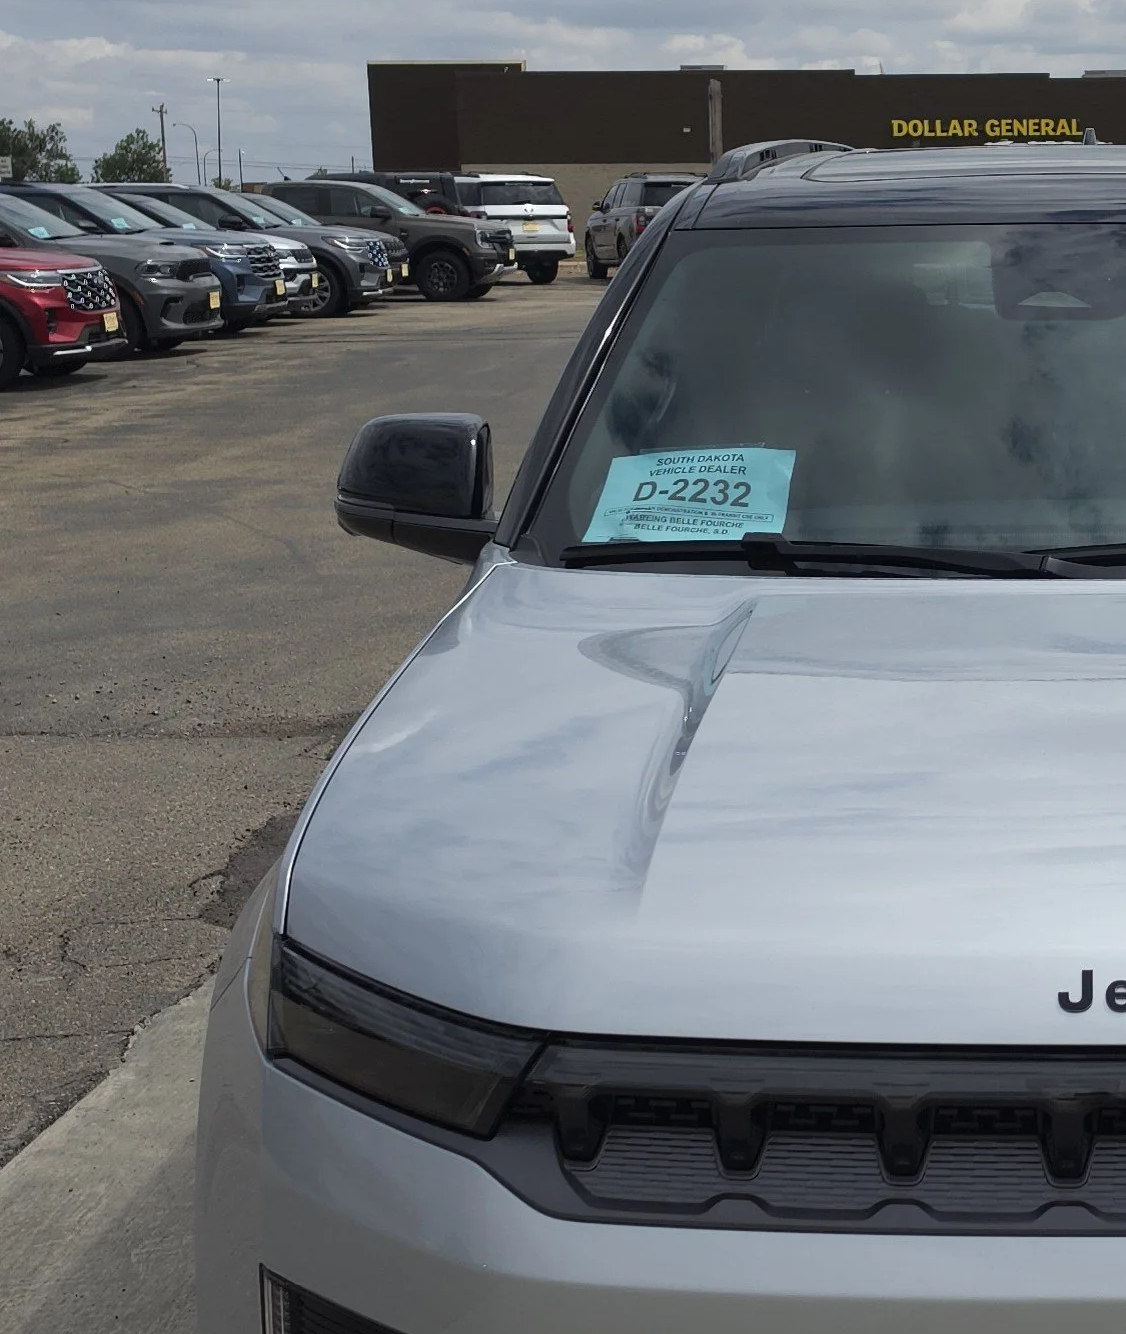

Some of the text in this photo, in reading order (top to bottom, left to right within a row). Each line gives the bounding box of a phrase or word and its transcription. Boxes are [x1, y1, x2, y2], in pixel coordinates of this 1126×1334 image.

[891, 118, 1084, 137] DOLLAR GENERAL
[656, 453, 745, 467] SOUTH DAKOTA
[649, 465, 747, 477] VEHICLE DEALER
[632, 478, 752, 508] D-2232
[634, 523, 664, 531] BELLE
[669, 517, 698, 526] BELLE
[700, 518, 745, 529] FOURCHE
